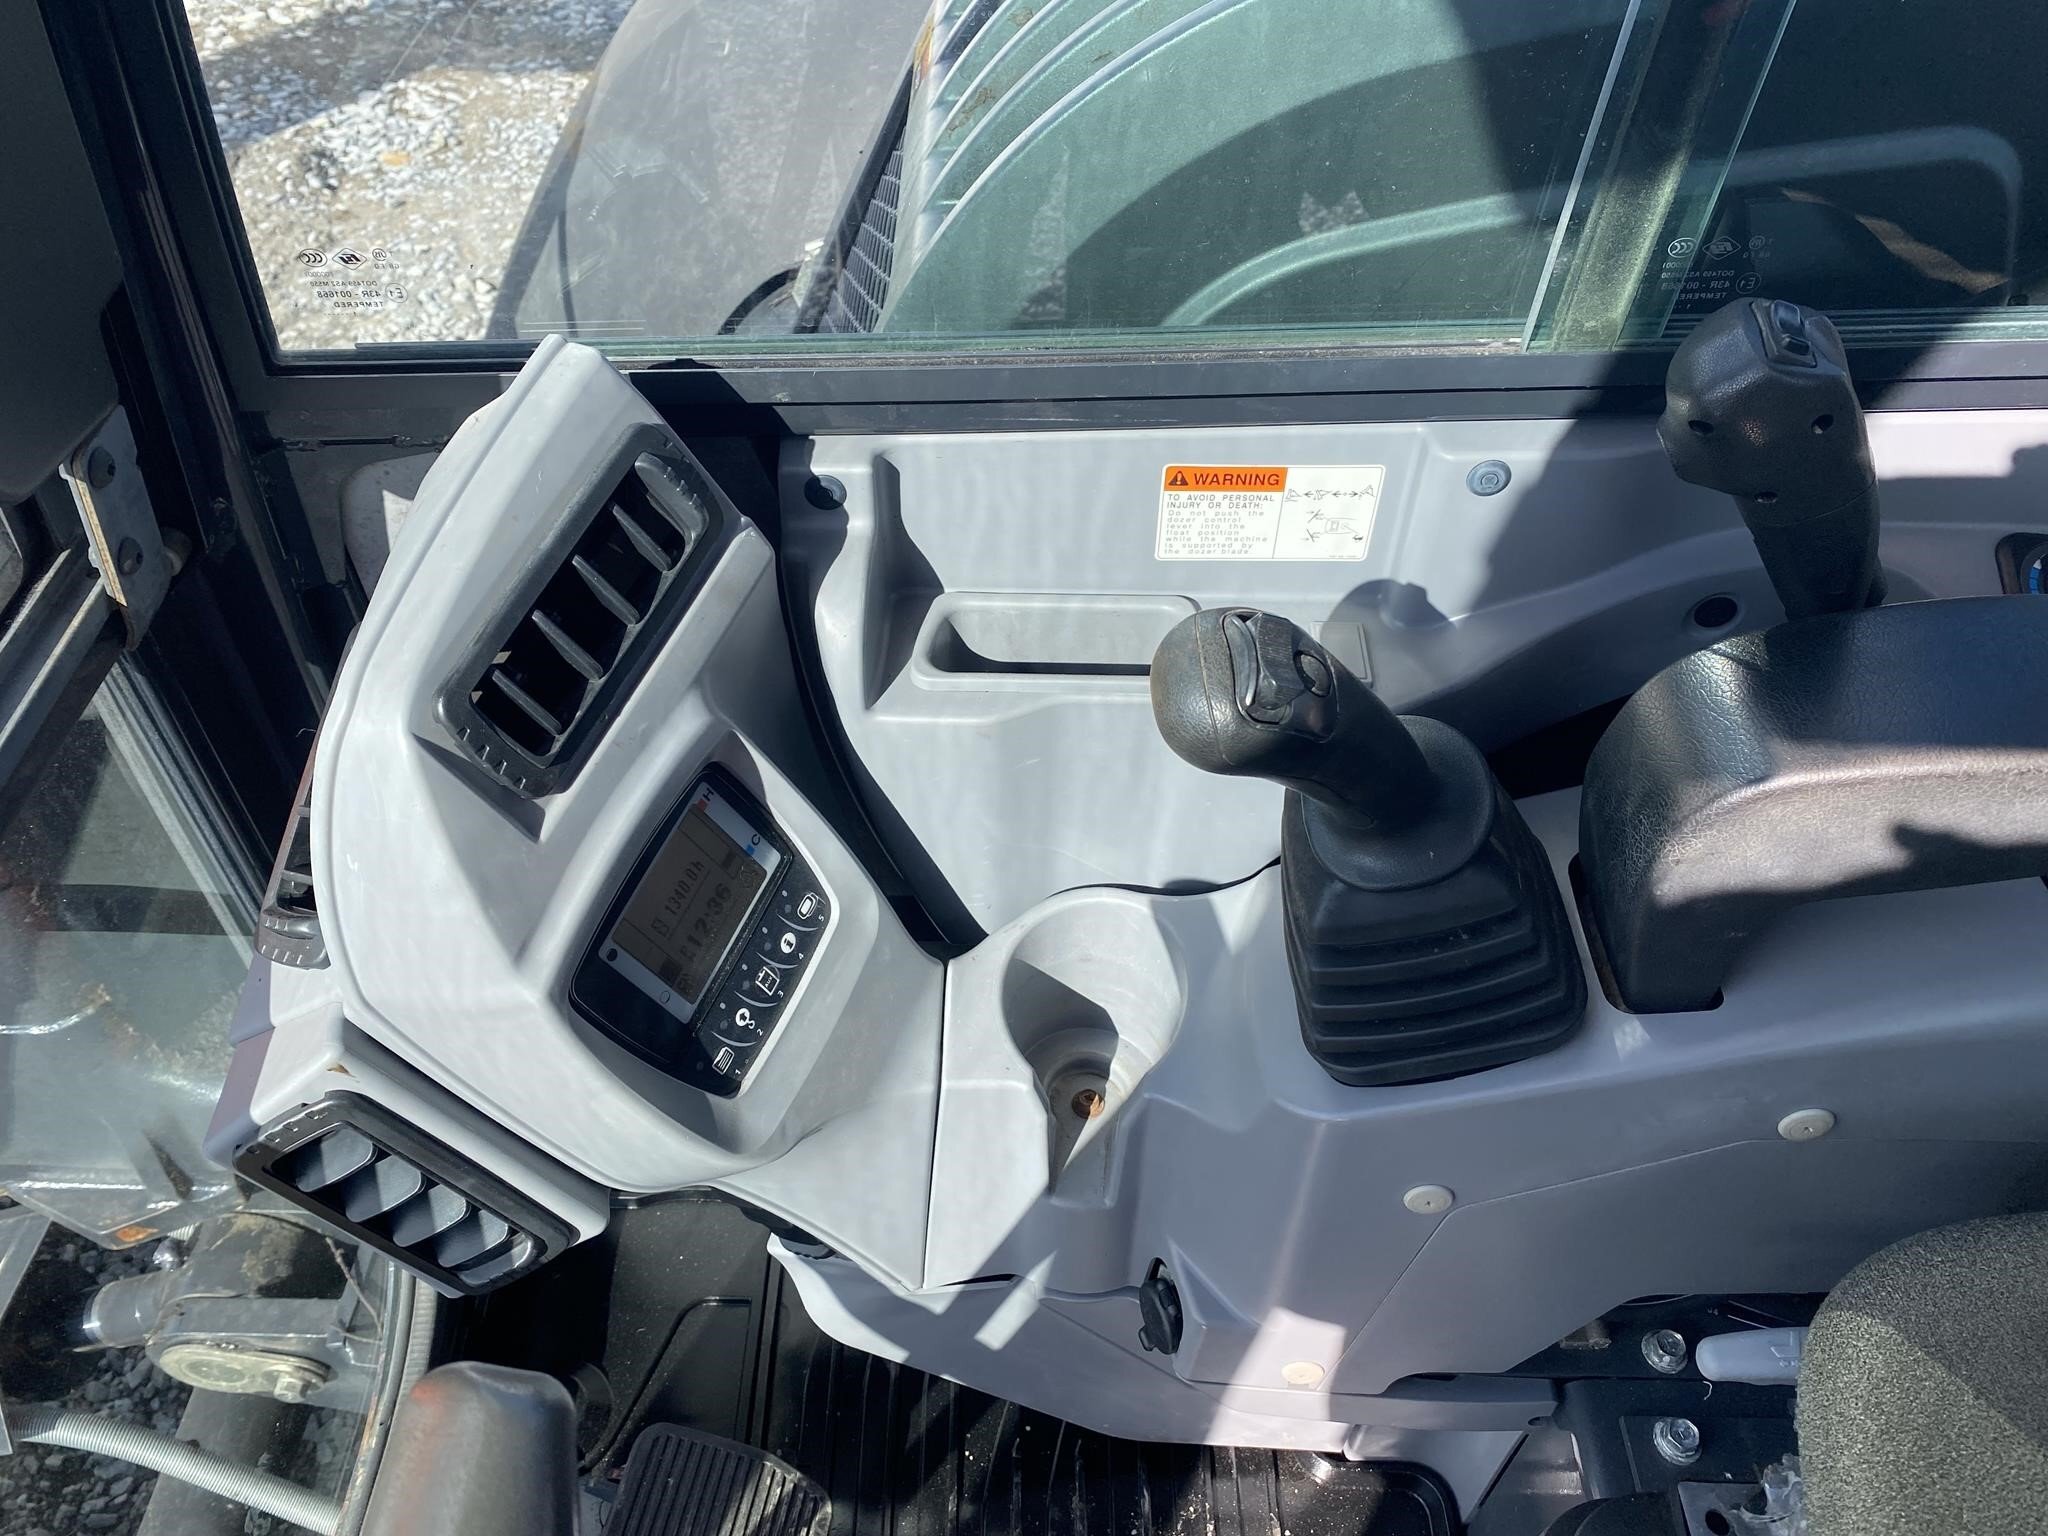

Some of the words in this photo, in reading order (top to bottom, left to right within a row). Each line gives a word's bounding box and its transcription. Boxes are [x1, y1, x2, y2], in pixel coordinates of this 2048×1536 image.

[1194, 473, 1280, 485] WARNING
[703, 788, 714, 802] H
[751, 834, 761, 846] C
[798, 952, 804, 960] 4
[765, 976, 773, 987] AUX
